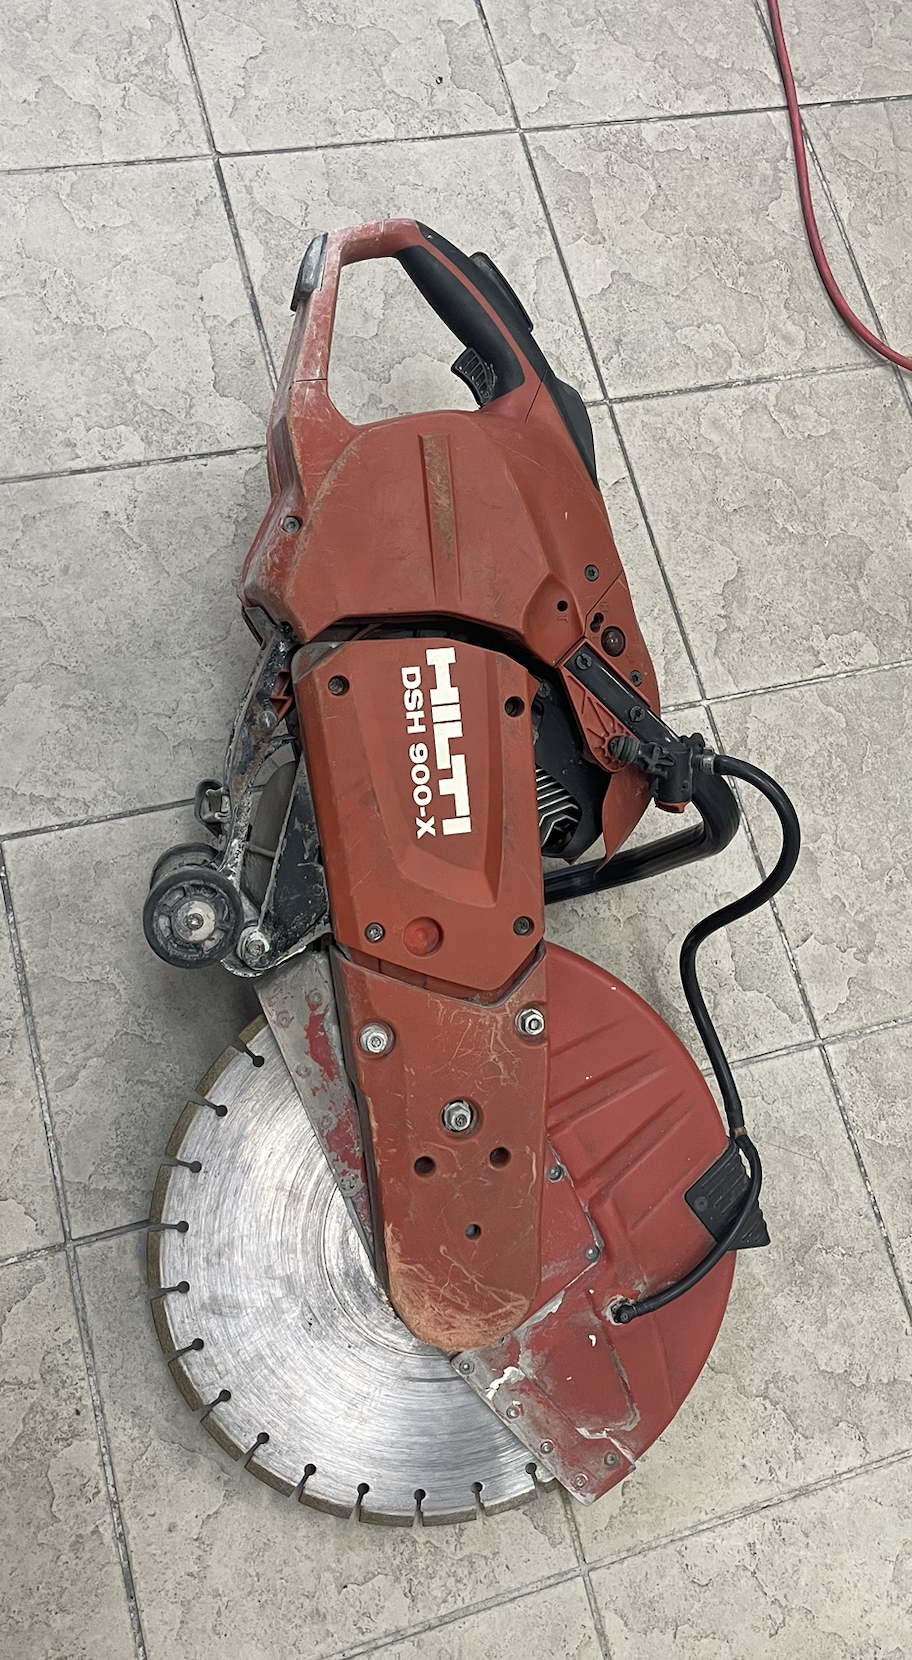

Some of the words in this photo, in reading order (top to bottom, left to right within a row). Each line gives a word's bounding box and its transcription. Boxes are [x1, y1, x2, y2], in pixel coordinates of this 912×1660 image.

[401, 666, 426, 734] DSH
[425, 646, 472, 837] HILTI
[408, 742, 436, 840] 900-X
